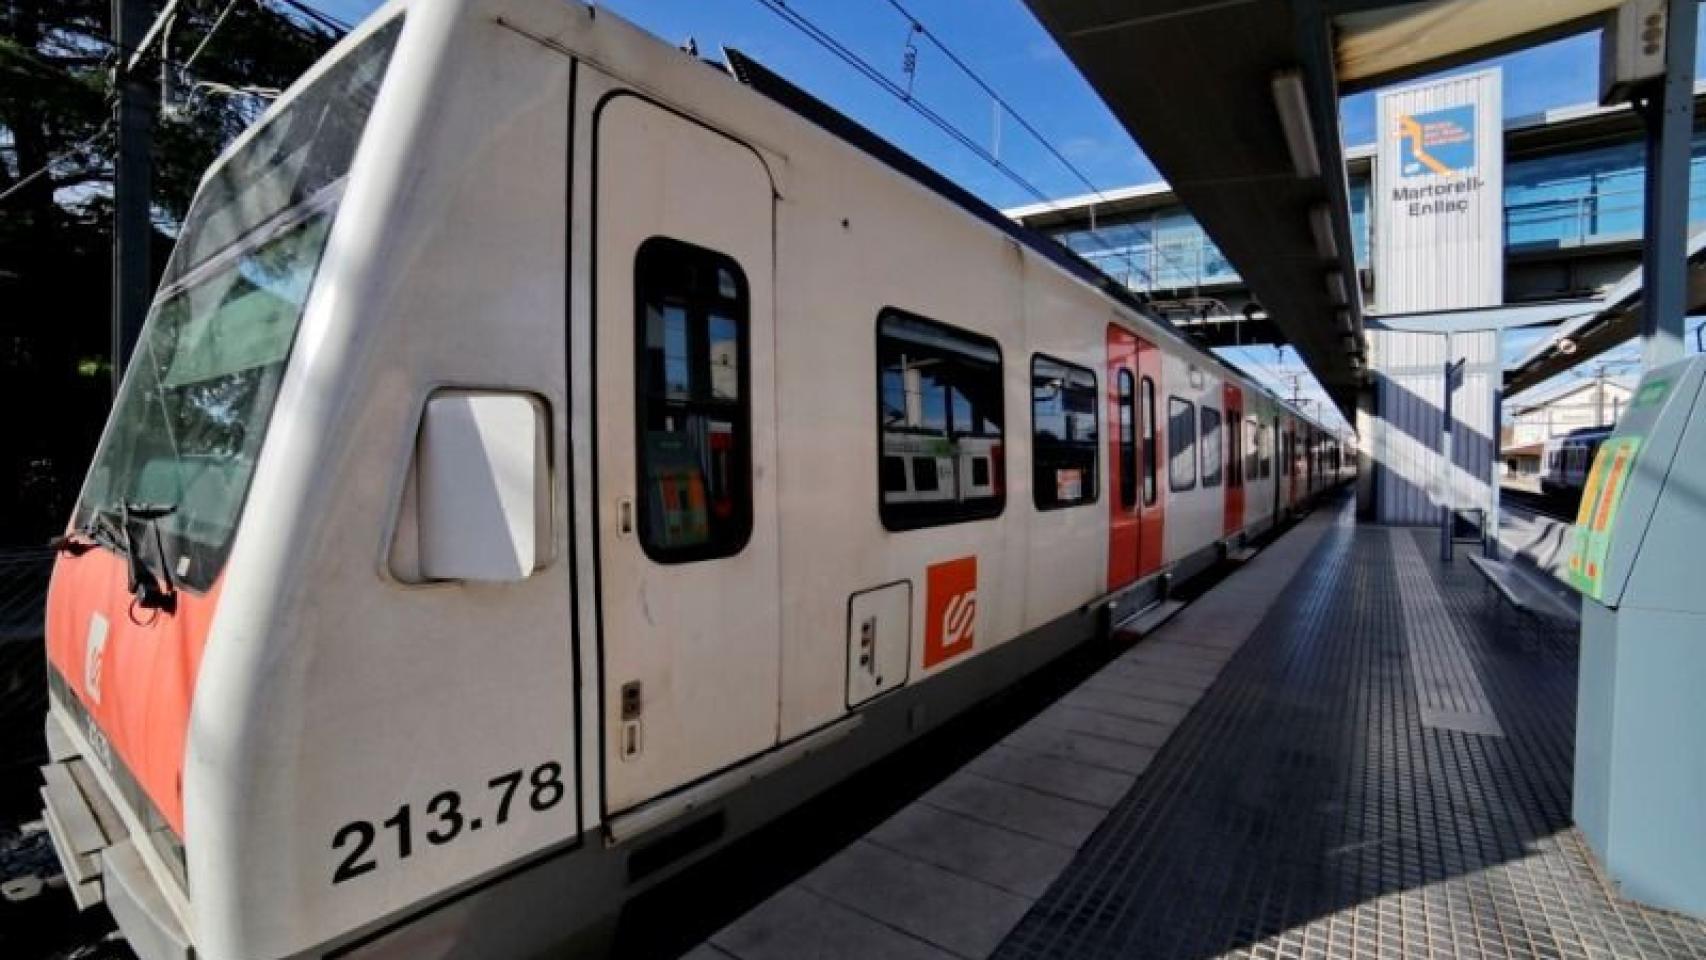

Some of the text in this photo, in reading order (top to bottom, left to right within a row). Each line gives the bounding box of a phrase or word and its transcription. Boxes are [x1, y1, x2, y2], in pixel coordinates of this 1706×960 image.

[1393, 176, 1485, 200] Martorell-
[1409, 200, 1468, 217] Enllaç
[332, 761, 564, 884] 213.78
